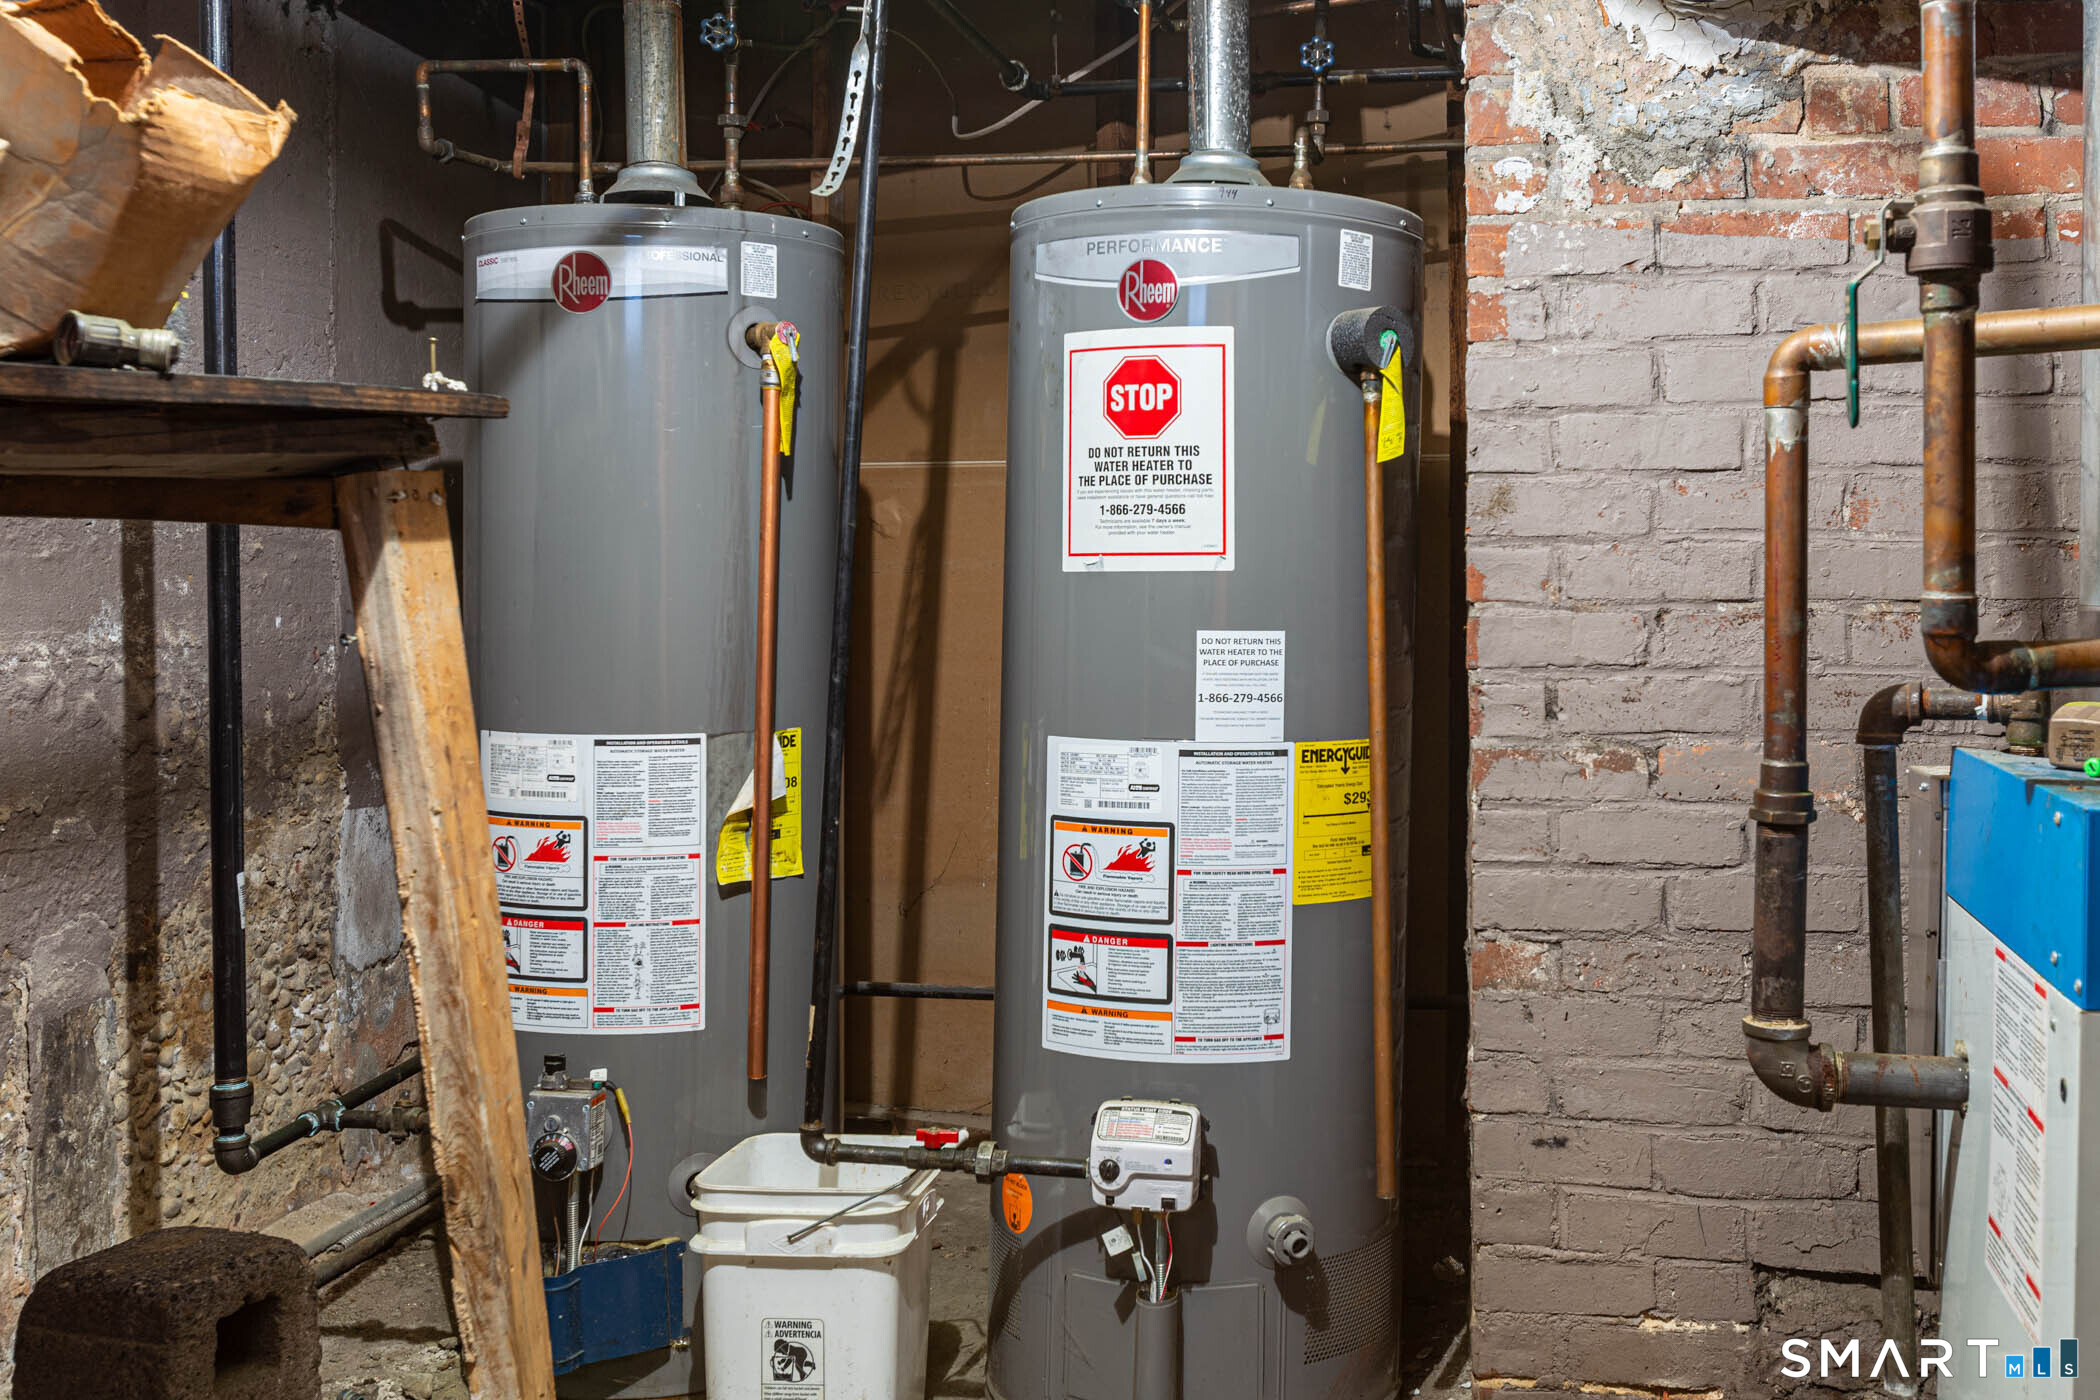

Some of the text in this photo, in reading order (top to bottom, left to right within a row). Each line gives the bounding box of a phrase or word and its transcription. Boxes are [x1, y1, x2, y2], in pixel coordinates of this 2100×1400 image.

[1087, 237, 1223, 256] PERFORMANCE
[558, 253, 608, 304] Rheem
[1125, 260, 1175, 312] Rheem
[1110, 383, 1173, 412] STOP
[1088, 445, 1200, 459] DO NOT RETURN THIS
[1094, 459, 1193, 472] WATER HEATER TO
[1079, 473, 1213, 487] THE PLACE OF PURCHASE
[1099, 503, 1186, 516] 1-866-279-4566
[1198, 693, 1283, 703] 1-866-279-4566
[514, 820, 551, 828] WARNING
[1091, 826, 1133, 835] WARNING
[513, 920, 545, 928] DANGER
[1092, 937, 1128, 945] DANGER
[514, 986, 548, 995] WARNING
[1090, 1008, 1129, 1018] WARNING
[774, 1321, 812, 1329] WARNING
[774, 1330, 822, 1338] ADVERTENCIA
